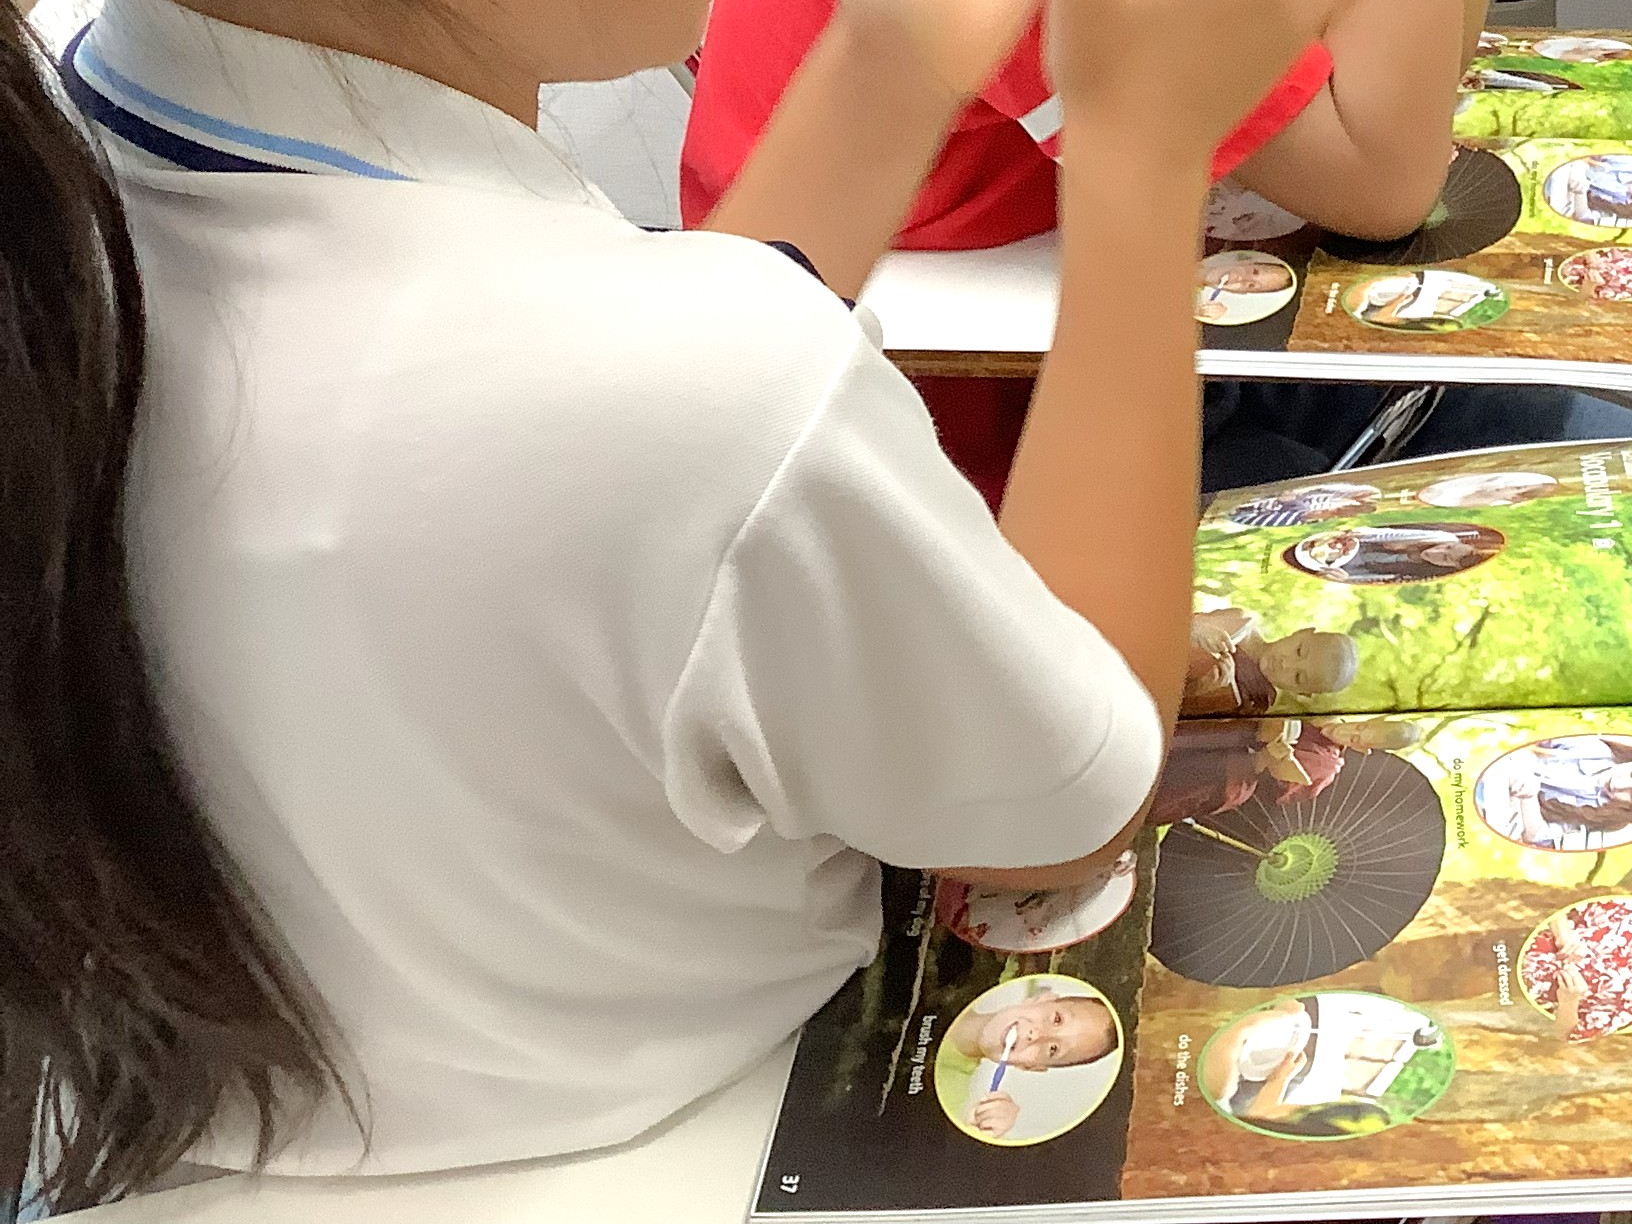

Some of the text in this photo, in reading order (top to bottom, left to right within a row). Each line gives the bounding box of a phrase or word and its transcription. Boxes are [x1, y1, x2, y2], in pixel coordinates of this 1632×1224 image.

[1451, 758, 1469, 849] do my homework
[906, 916, 924, 937] dog
[1492, 944, 1514, 1006] get dressed
[907, 1015, 938, 1095] brush my teeth
[1173, 1034, 1192, 1107] do the dishes
[780, 1174, 800, 1193] 37
